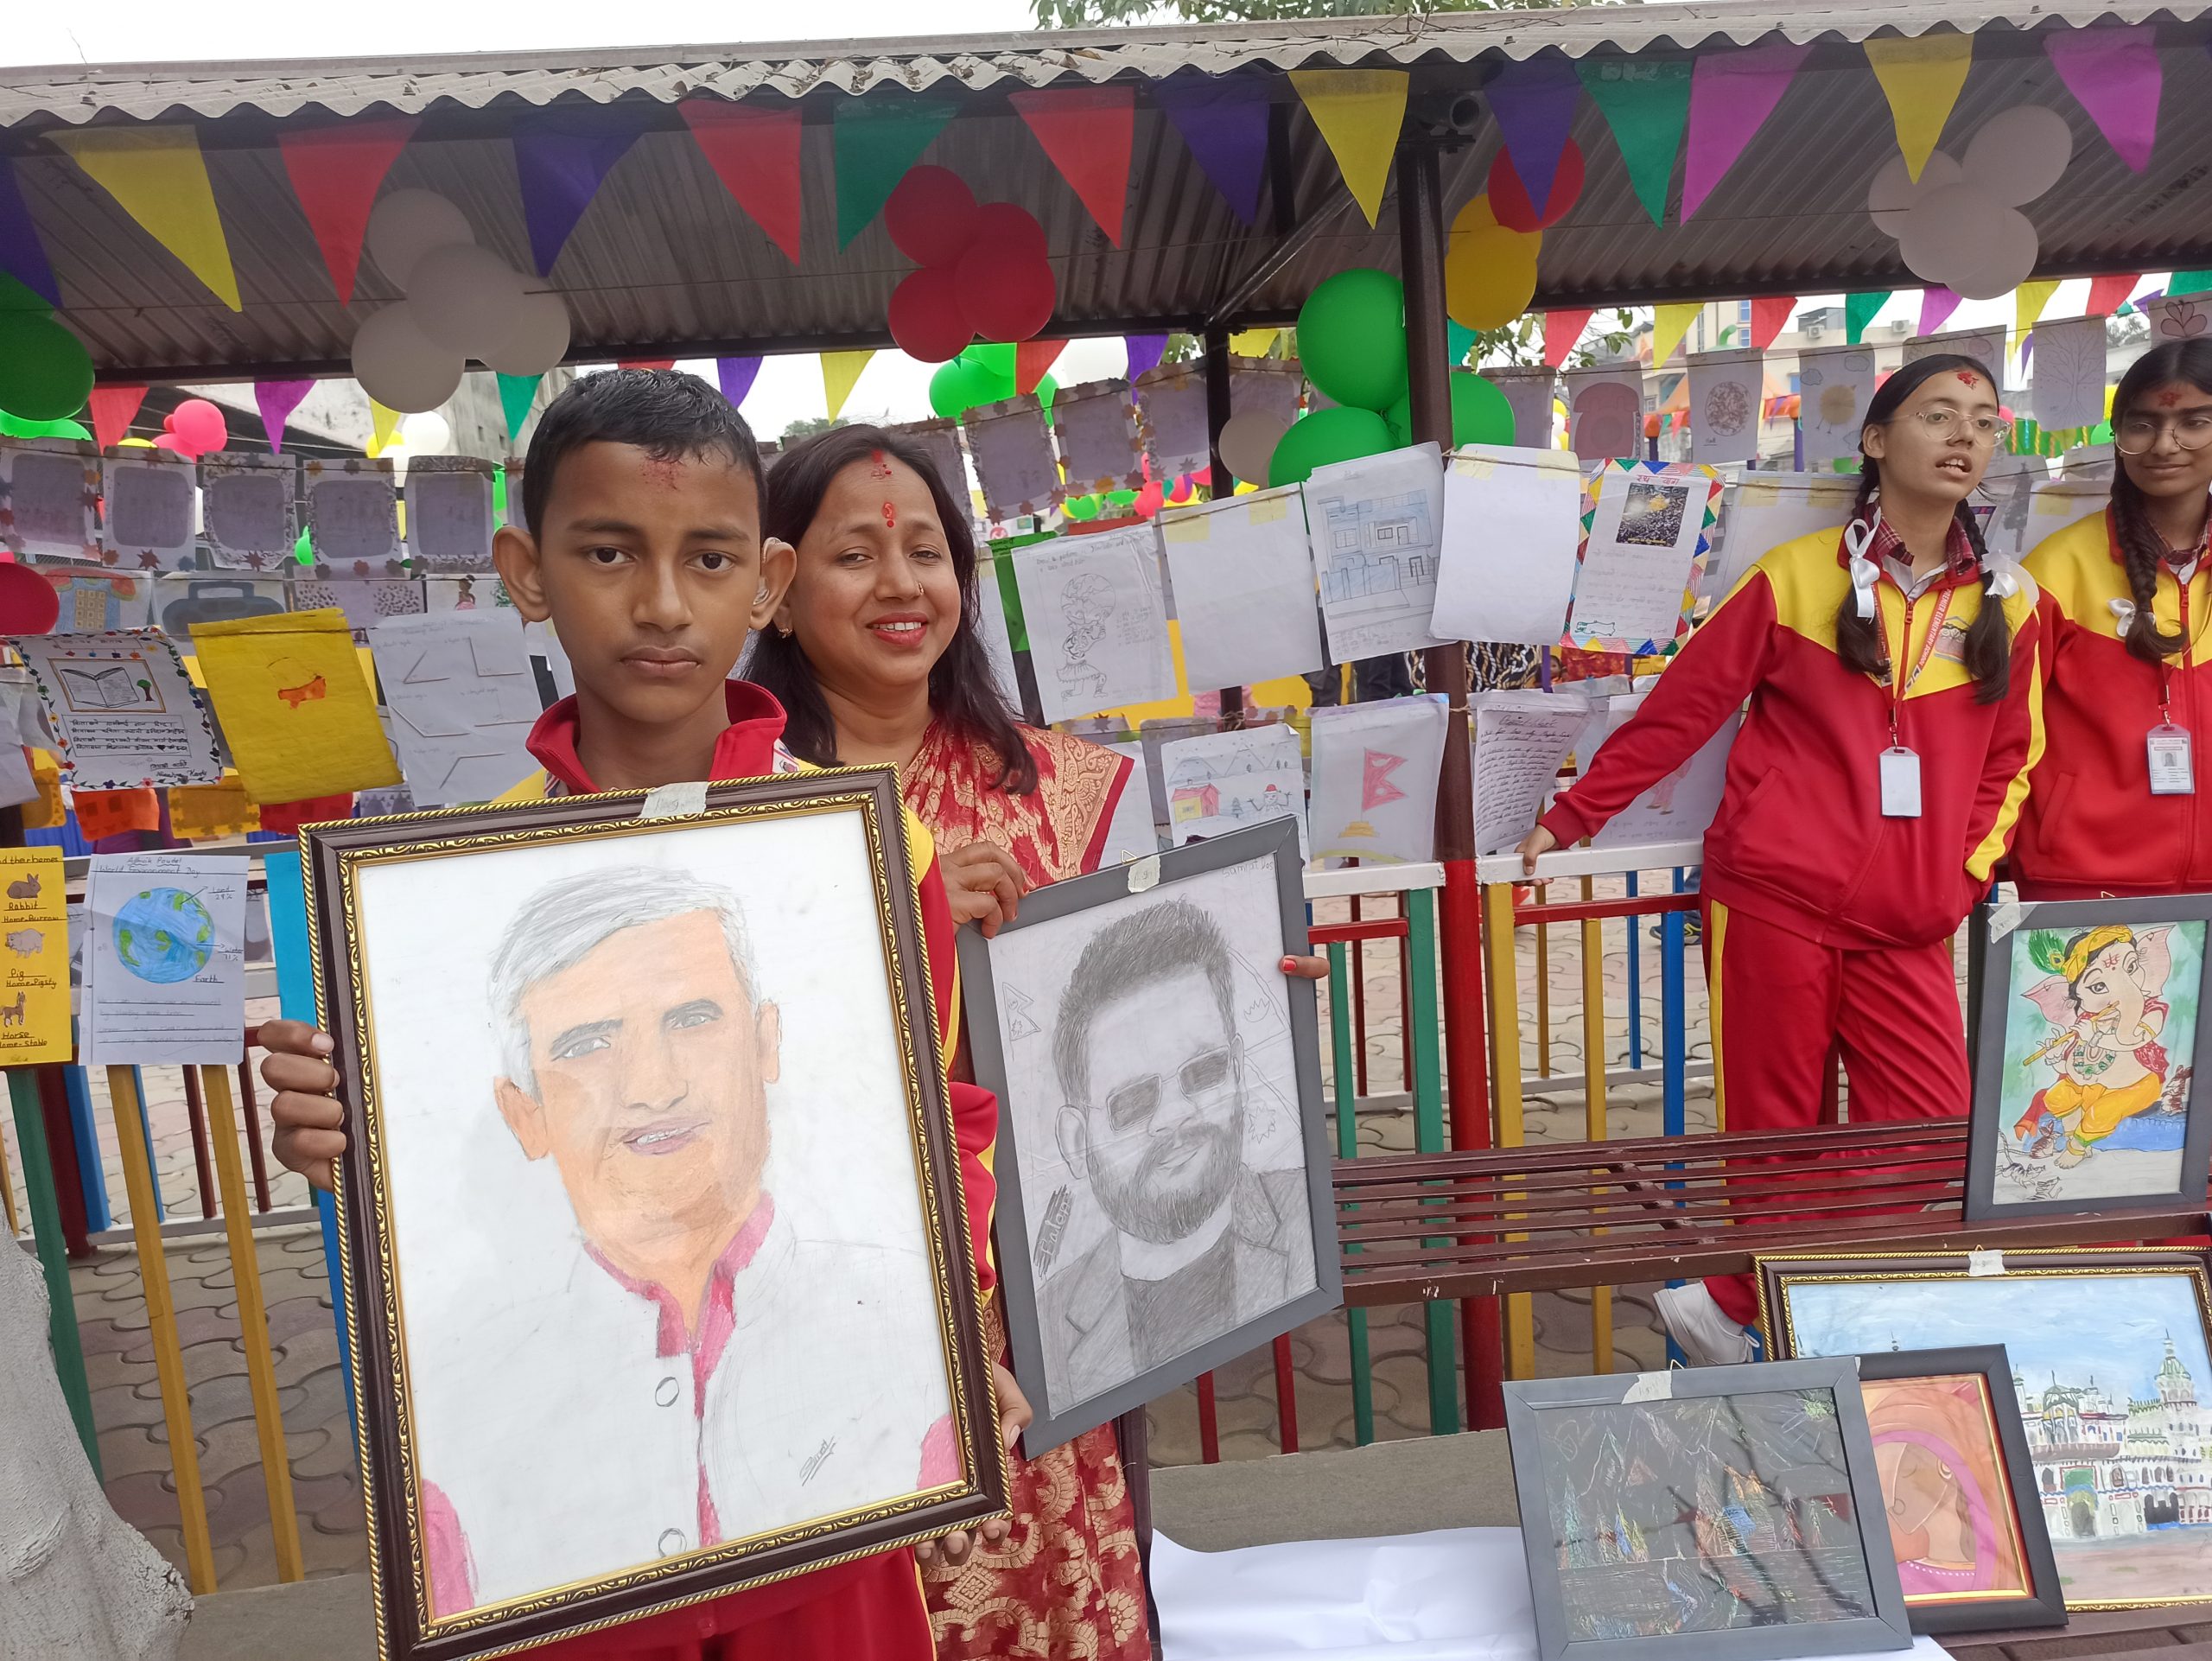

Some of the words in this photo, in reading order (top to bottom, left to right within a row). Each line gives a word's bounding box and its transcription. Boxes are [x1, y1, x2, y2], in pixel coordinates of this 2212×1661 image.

[1938, 589, 1952, 612] PREMIER
[1927, 612, 1943, 646] ELEMENTARY
[1919, 644, 1931, 665] SCHOOL
[187, 867, 200, 878] Day
[9, 901, 39, 911] Rabbit
[10, 968, 24, 982] Pig
[194, 974, 218, 983] Earth
[3, 1031, 29, 1040] Horse
